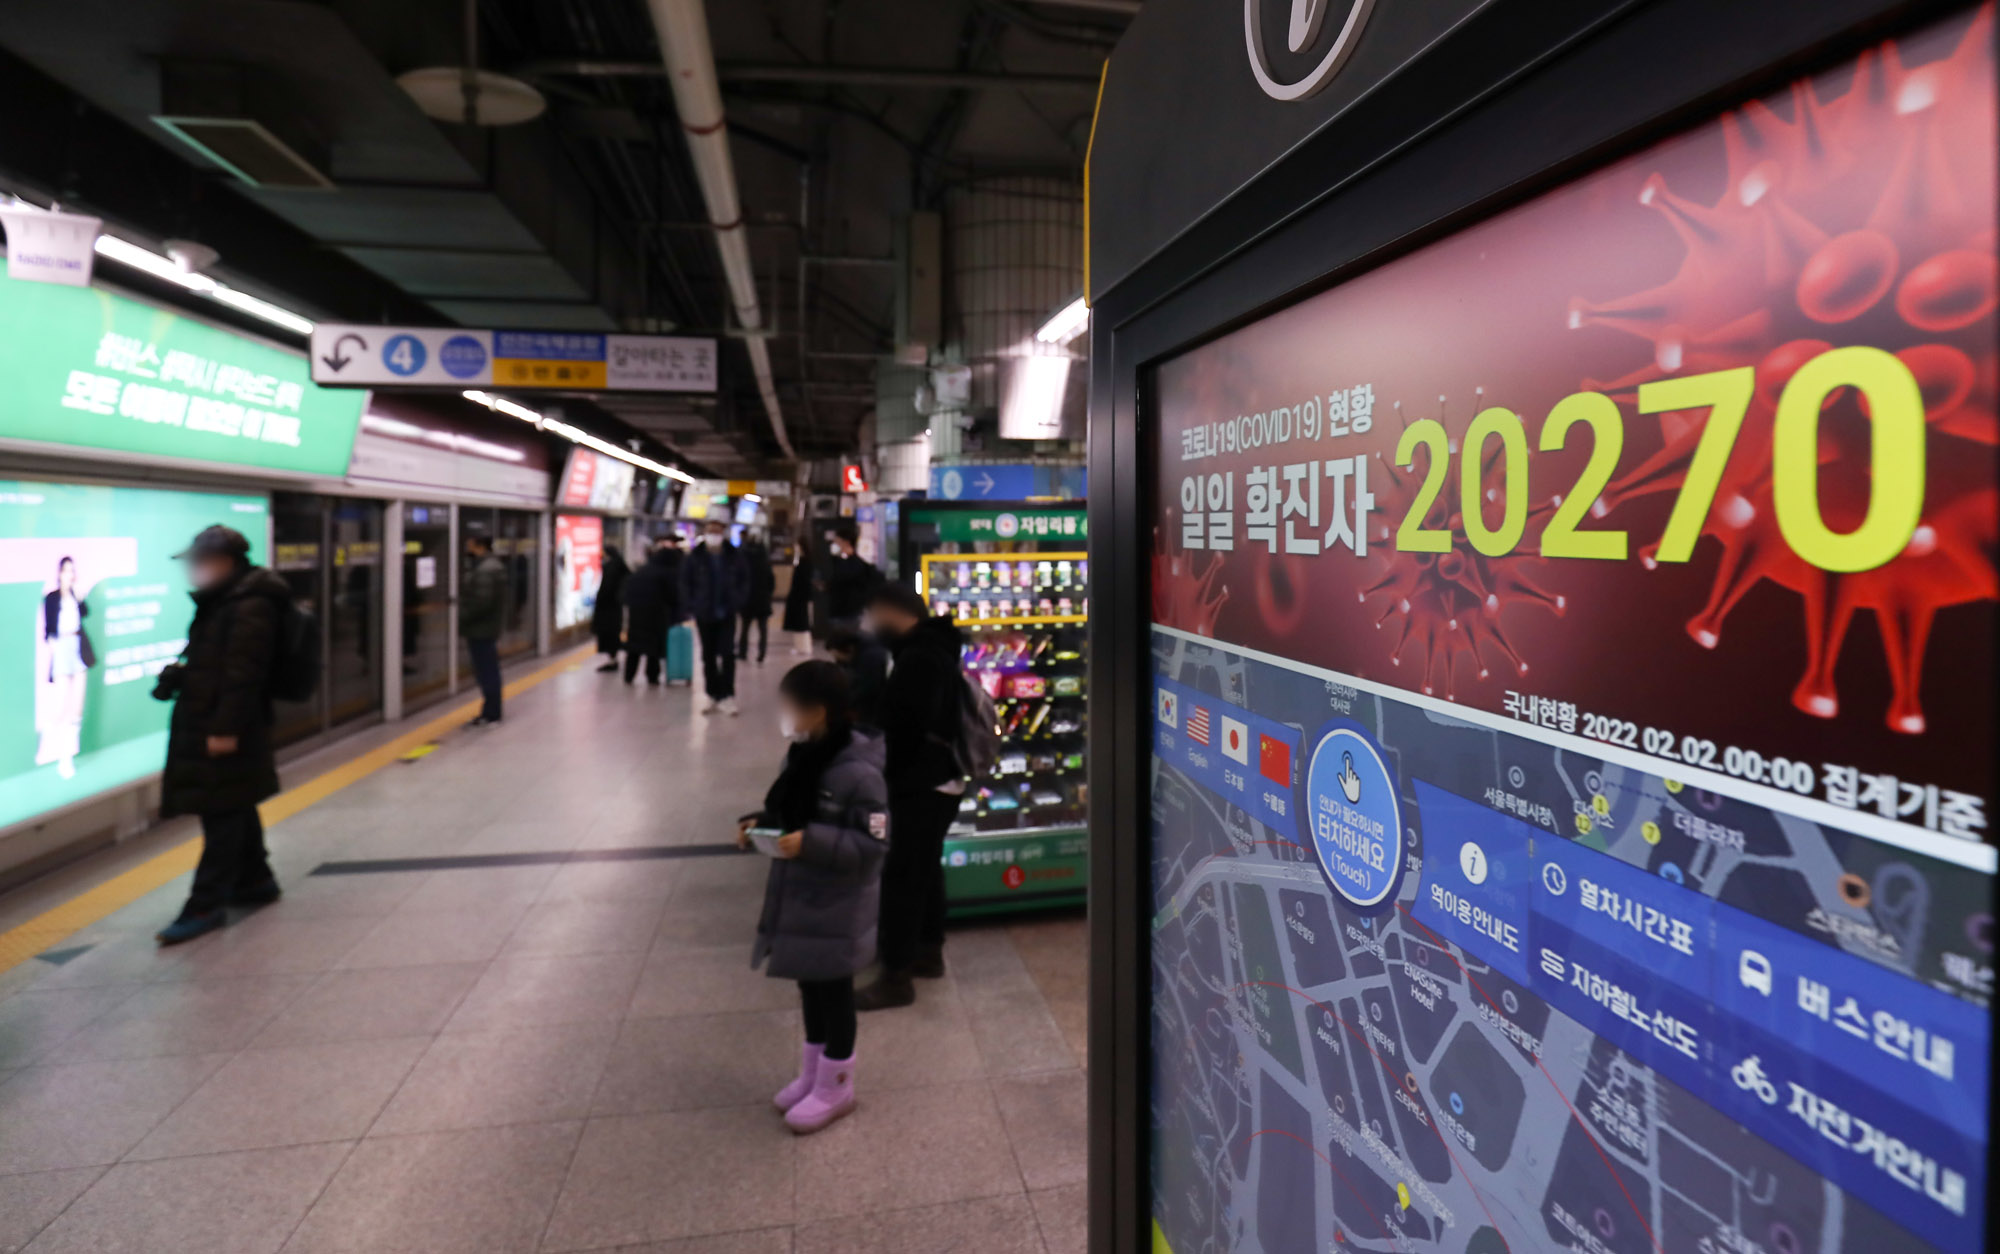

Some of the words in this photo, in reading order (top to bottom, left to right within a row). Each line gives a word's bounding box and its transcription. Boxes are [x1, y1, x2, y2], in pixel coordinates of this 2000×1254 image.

[390, 339, 413, 371] 4
[1181, 395, 1323, 461] 코로나19(COVID19)
[1328, 383, 1375, 438] 현황
[1394, 346, 1926, 573] 20270
[1021, 516, 1077, 535] 자일리톨
[1181, 472, 1234, 551] 일일
[1246, 454, 1375, 557] 확진자
[1330, 697, 1351, 715] 대사관
[1188, 747, 1209, 770] English
[1224, 768, 1245, 792] 日本語
[1503, 690, 1578, 733] 국내현황
[1582, 713, 1638, 749] 2022
[1822, 763, 1988, 842] 집계기준
[1319, 794, 1341, 819] 안내가
[1342, 807, 1384, 842] 필요하시면
[1484, 786, 1551, 826] 서울특별시청
[1318, 815, 1385, 873] 터치하세요
[1673, 811, 1747, 851] 더플라자
[1331, 851, 1372, 891] (Touch)
[1431, 883, 1520, 953] 역이용안내도
[1579, 878, 1694, 956] 열차시간표
[1346, 924, 1385, 962] KB국민은행
[1410, 984, 1435, 1012] Hotel
[1570, 962, 1699, 1060] 지하철노선도
[1797, 975, 1955, 1082] 버스안내
[1394, 1088, 1428, 1126] 스타벅스
[1590, 1100, 1649, 1158] 주민센터
[1438, 1109, 1476, 1152] 신한은행
[1786, 1081, 1967, 1217] 자전거안내
